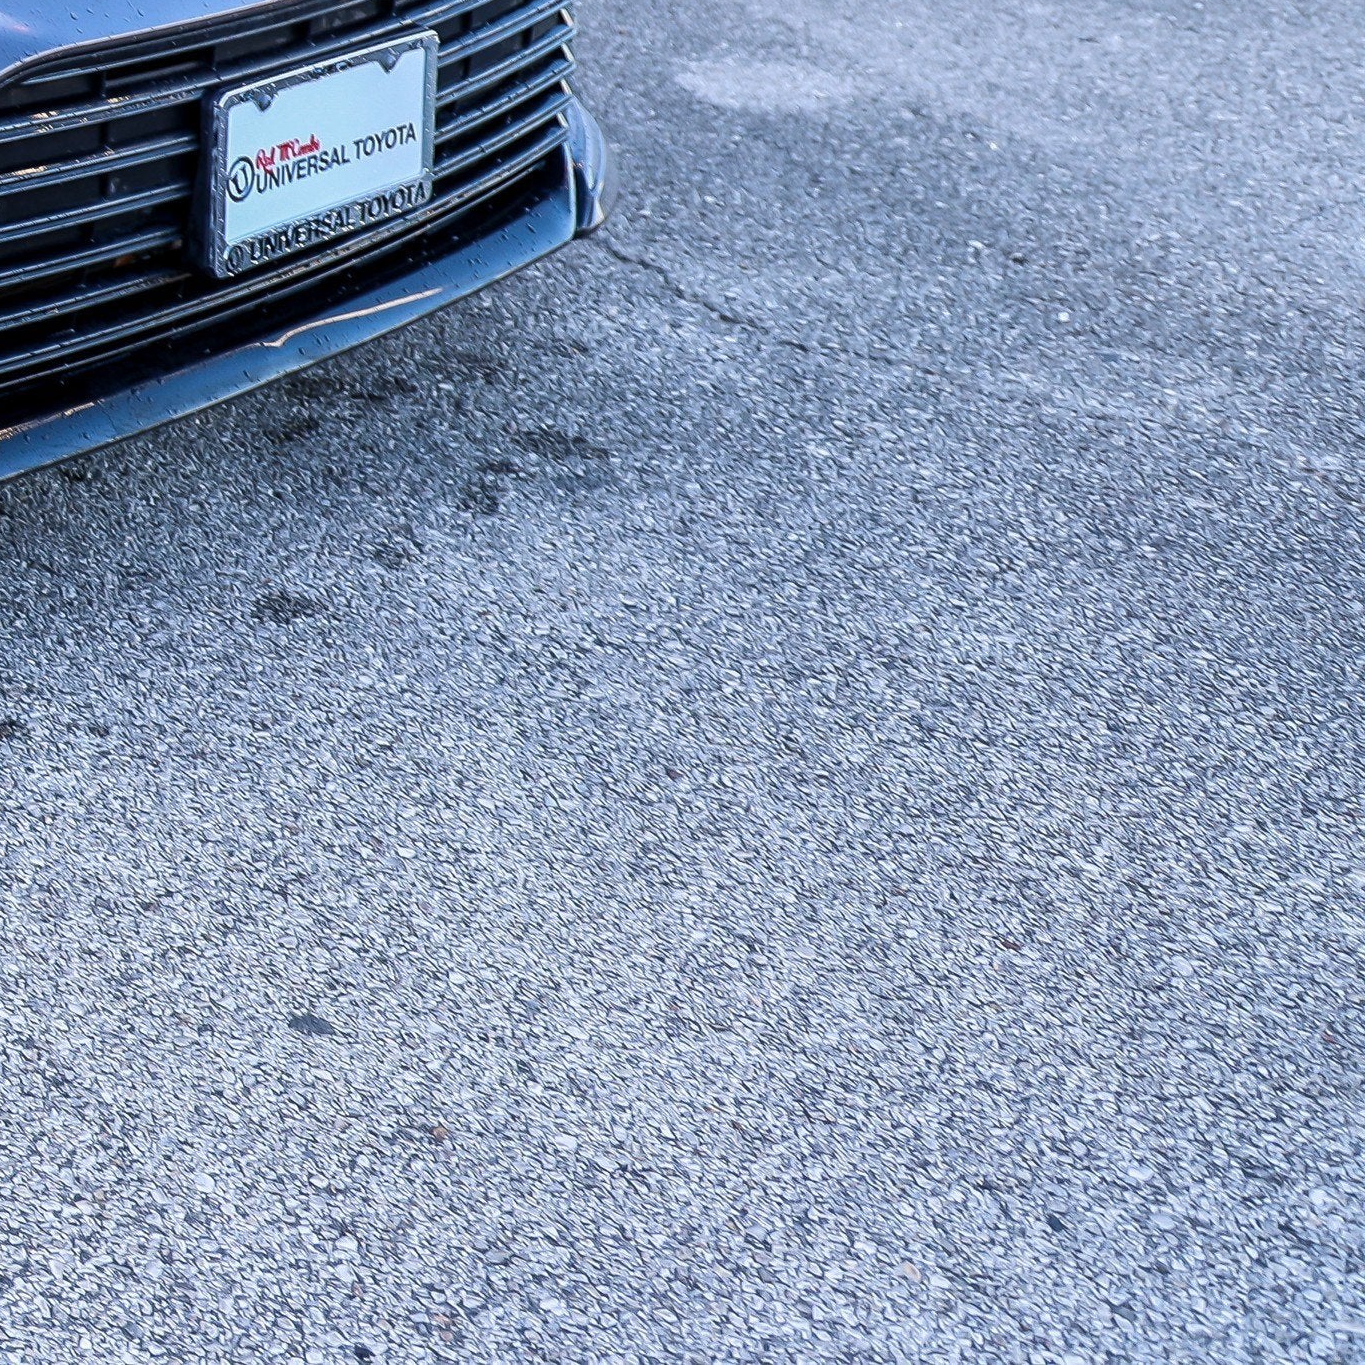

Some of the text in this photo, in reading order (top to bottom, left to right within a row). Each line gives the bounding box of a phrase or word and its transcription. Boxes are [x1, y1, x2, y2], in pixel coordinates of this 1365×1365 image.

[256, 144, 350, 194] UNIVERSAL
[352, 122, 417, 160] TOYOTA
[249, 205, 354, 264] UNIVERSAL
[354, 181, 427, 223] TOYOTA
